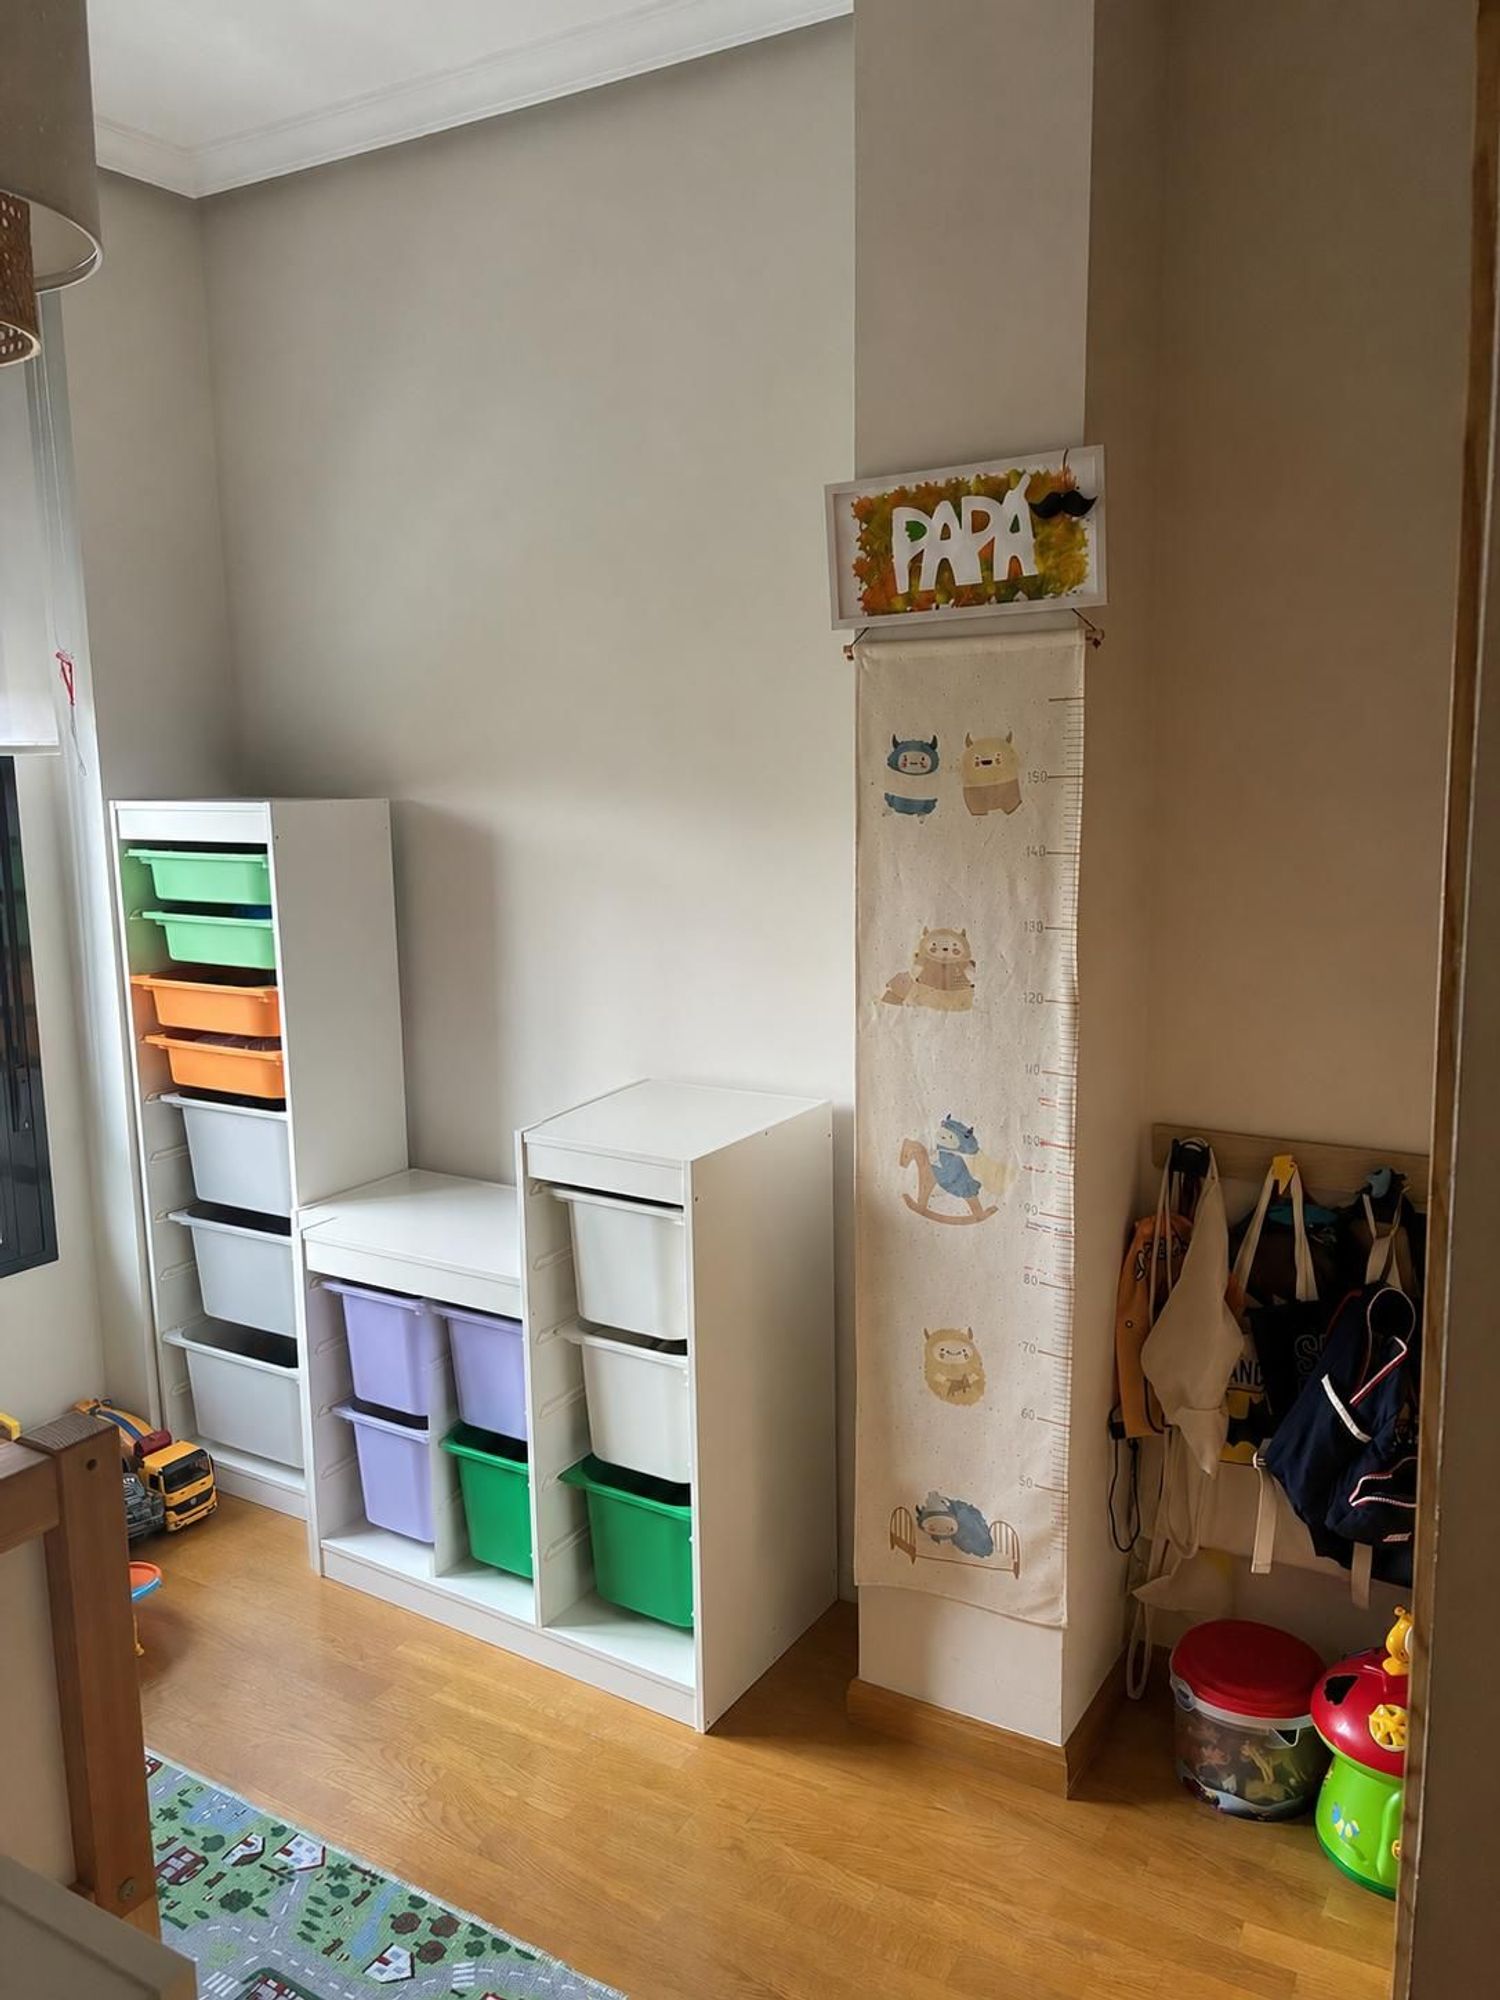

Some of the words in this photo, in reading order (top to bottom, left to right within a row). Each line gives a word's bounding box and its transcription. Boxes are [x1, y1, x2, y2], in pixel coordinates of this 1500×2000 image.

[892, 473, 1039, 594] PAPÁ
[1027, 769, 1048, 785] 150
[1025, 844, 1046, 859] 140
[1023, 919, 1043, 935] 130
[1023, 992, 1044, 1006] 120
[1023, 1063, 1040, 1077] 110
[1022, 1134, 1040, 1148] 100
[1023, 1203, 1039, 1217] 90
[1023, 1273, 1039, 1287] 80
[1021, 1340, 1037, 1355] 70
[1020, 1407, 1036, 1422] 60
[1018, 1475, 1034, 1490] 50
